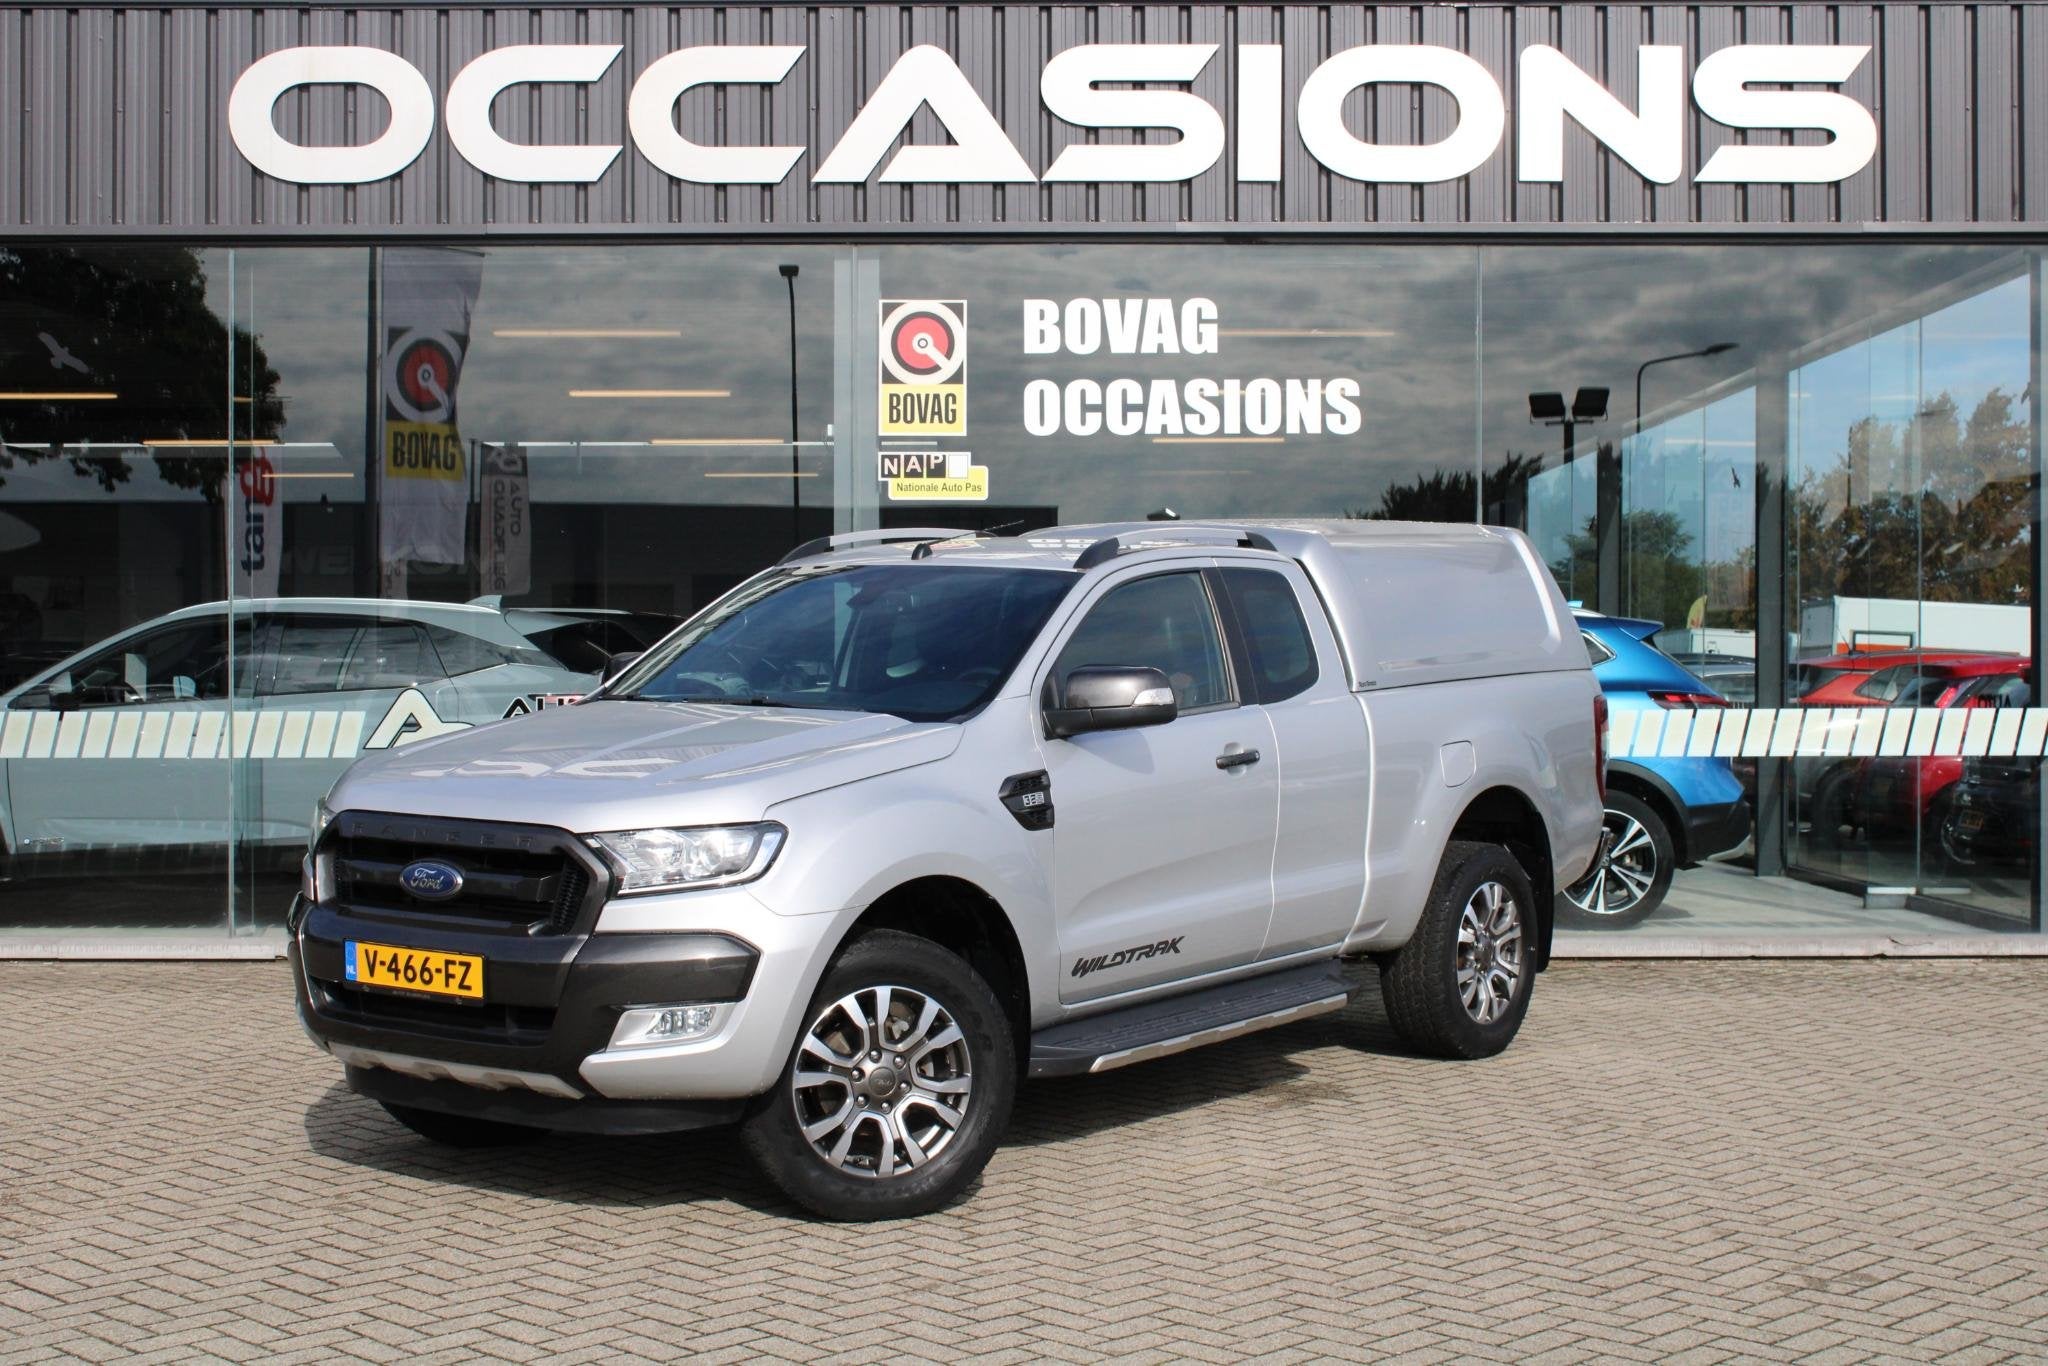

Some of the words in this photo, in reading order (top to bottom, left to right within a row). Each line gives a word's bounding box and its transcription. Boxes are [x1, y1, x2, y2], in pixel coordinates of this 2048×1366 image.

[228, 44, 1878, 184] OCCASIONS
[1024, 298, 1218, 355] BOVAG
[888, 392, 957, 424] BOVAG
[1024, 378, 1362, 436] OCCASIONS
[392, 431, 457, 471] BOVAG
[896, 483, 939, 492] Nationale
[941, 483, 963, 492] Auto
[965, 483, 982, 492] Pas
[409, 867, 444, 890] Ford
[364, 948, 473, 991] V-466-FZ
[1071, 936, 1185, 978] WILDTRAK
